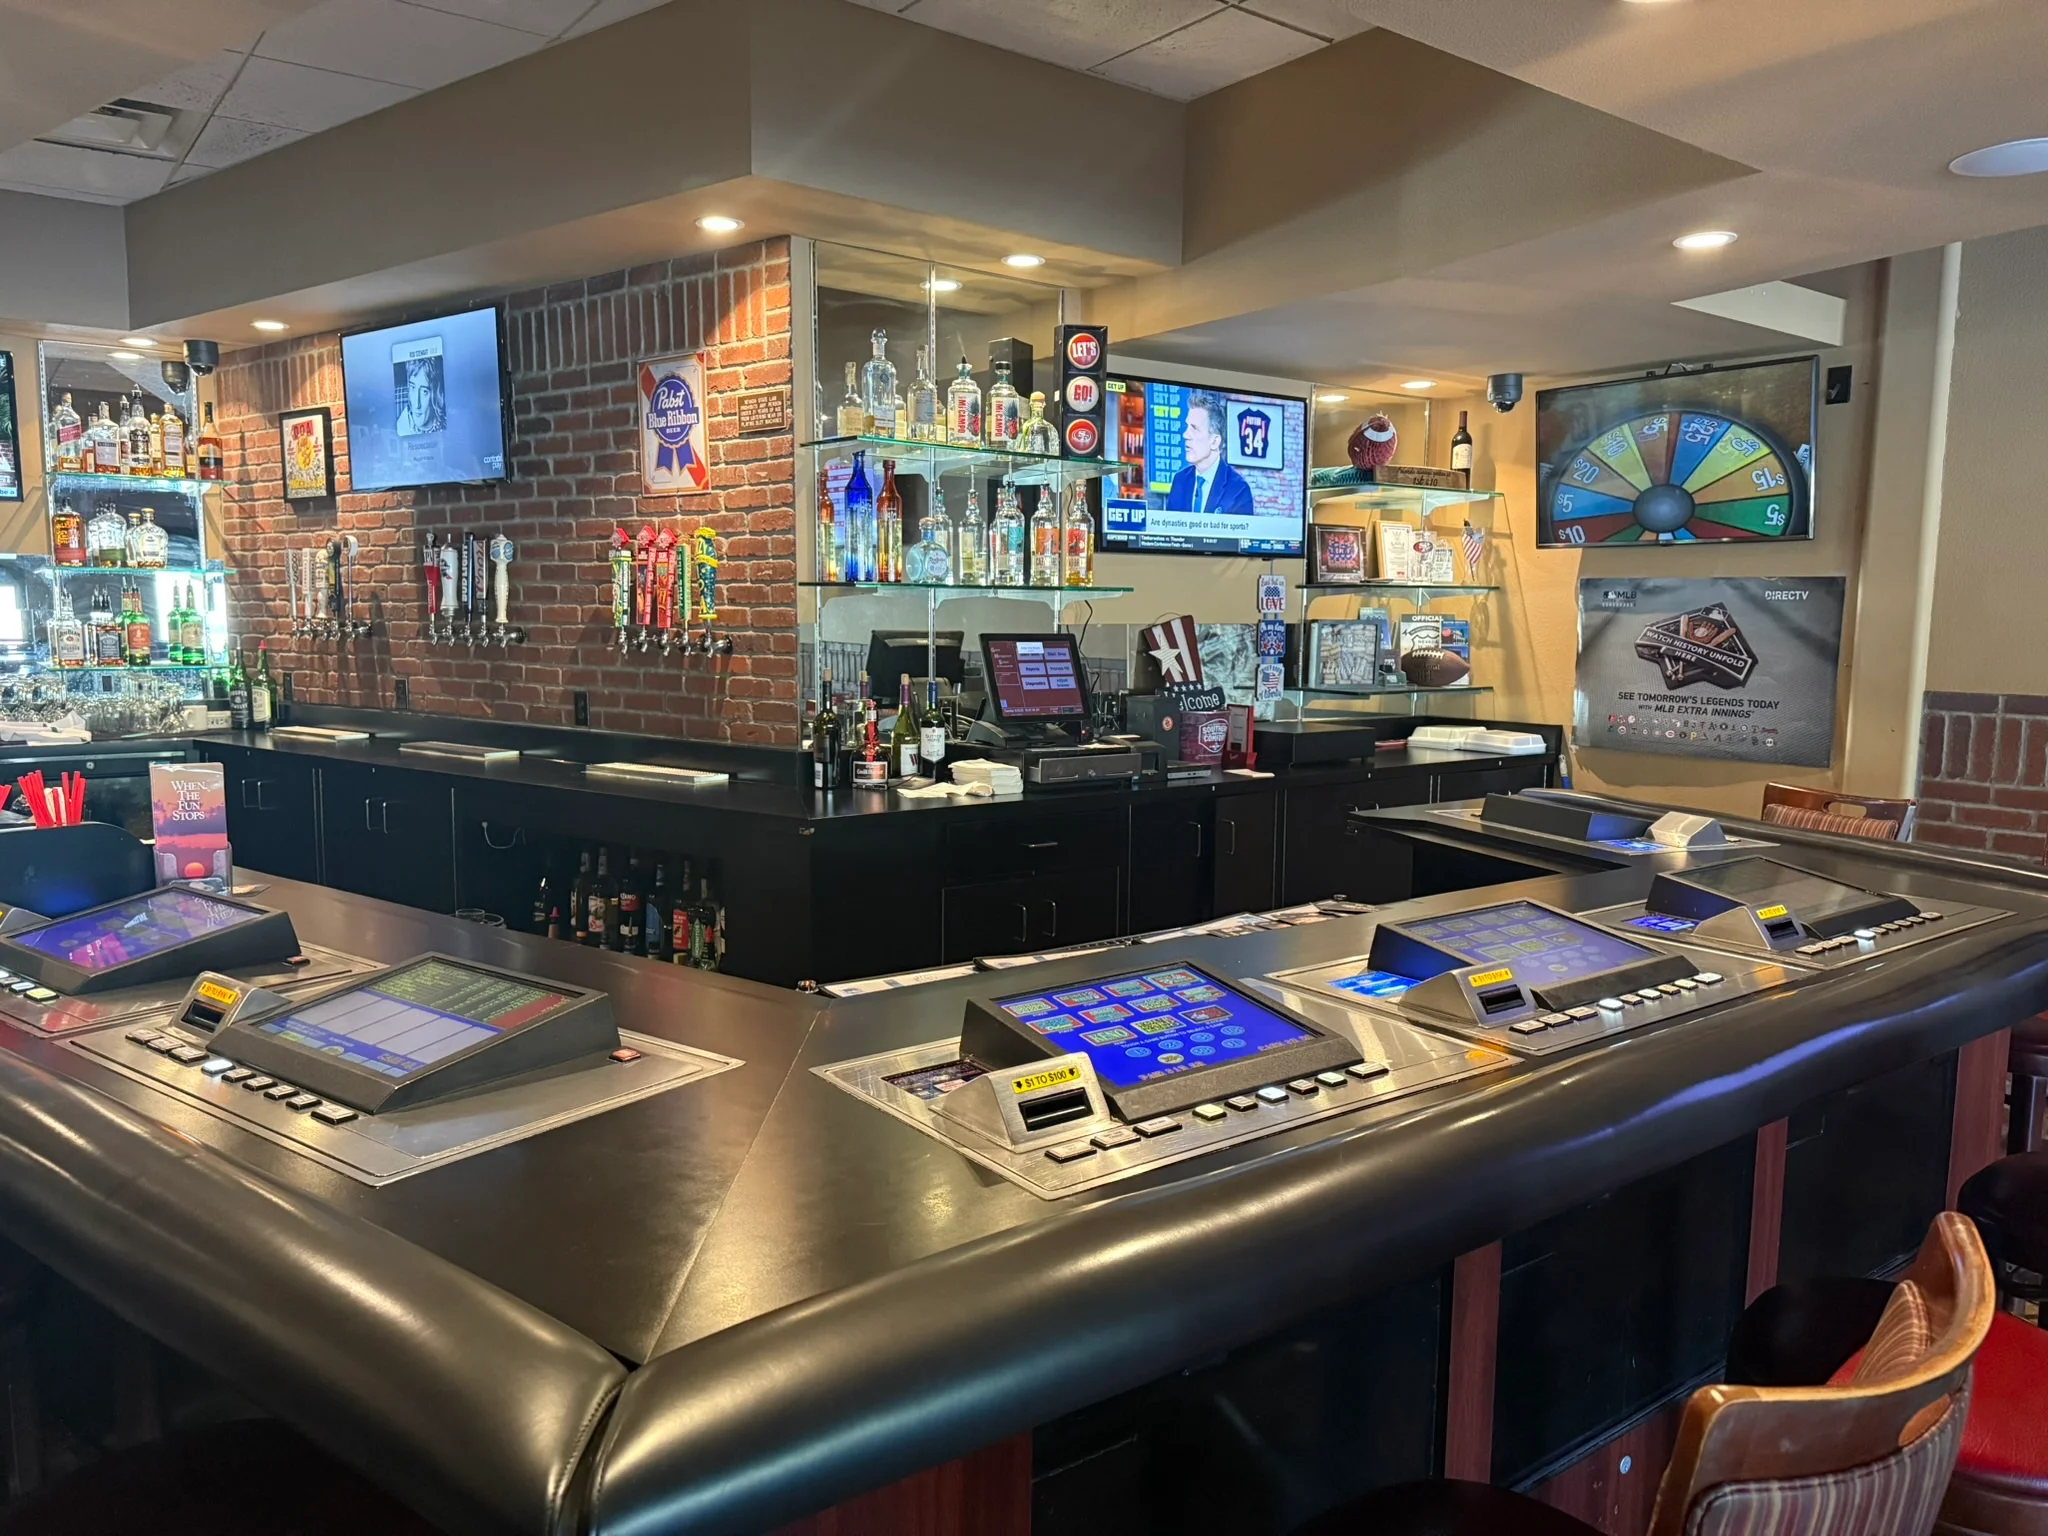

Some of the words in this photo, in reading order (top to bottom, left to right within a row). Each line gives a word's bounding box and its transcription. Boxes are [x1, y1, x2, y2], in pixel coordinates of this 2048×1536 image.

[1072, 342, 1096, 357] LET'S
[1074, 385, 1092, 402] GO!
[1107, 382, 1116, 391] GET
[1117, 383, 1124, 391] UP
[657, 386, 685, 409] Pabst
[958, 400, 967, 408] MI
[1154, 393, 1168, 403] GET
[1170, 395, 1180, 404] UP
[995, 404, 1004, 412] MI
[649, 413, 666, 429] Blue
[667, 410, 697, 427] Ribbon
[958, 410, 966, 433] CAMPO
[995, 414, 1003, 437] CAMPO
[1155, 419, 1169, 430] GET
[1171, 421, 1181, 431] UP
[1155, 433, 1169, 443] GET
[1171, 434, 1181, 444] UP
[1244, 428, 1263, 457] 34
[1155, 446, 1170, 456] GET
[1171, 447, 1182, 457] UP
[1155, 458, 1170, 469] GET
[1172, 459, 1182, 470] UP
[1572, 458, 1600, 485] $20
[1412, 476, 1424, 486] 1st
[1430, 478, 1438, 486] 10
[1751, 467, 1785, 491] $15
[1558, 493, 1575, 514] $5
[1108, 507, 1130, 522] GET
[1131, 509, 1146, 523] UP
[1764, 504, 1785, 527] $5
[1151, 518, 1160, 526] Are
[1162, 519, 1187, 528] dynasties
[1189, 521, 1202, 529] good
[1230, 523, 1249, 531] sports?
[1558, 525, 1586, 544] $10
[474, 541, 484, 593] Coors
[1617, 591, 1637, 599] MLB
[1765, 590, 1809, 600] DIRECTV
[1260, 598, 1284, 611] LOVE
[1646, 631, 1673, 645] WATCH
[1673, 639, 1708, 656] HISTORY
[1709, 651, 1745, 668] UNFOLD
[1675, 650, 1697, 663] HERE
[1618, 692, 1635, 701] SEE
[1638, 693, 1698, 705] TOMORROW'S
[1700, 697, 1744, 708] LEGENDS
[1747, 699, 1780, 710] TODAY
[1654, 704, 1674, 713] MLB
[1677, 706, 1709, 716] EXTRA
[1711, 708, 1752, 718] INNINGS
[171, 781, 206, 791] WHEN
[177, 791, 201, 801] THE
[178, 801, 201, 811] FUN
[172, 811, 205, 821] STOPS
[1087, 1029, 1129, 1043] KENO
[1025, 1078, 1035, 1088] $1
[1036, 1075, 1047, 1085] TO
[1048, 1071, 1067, 1083] $100
